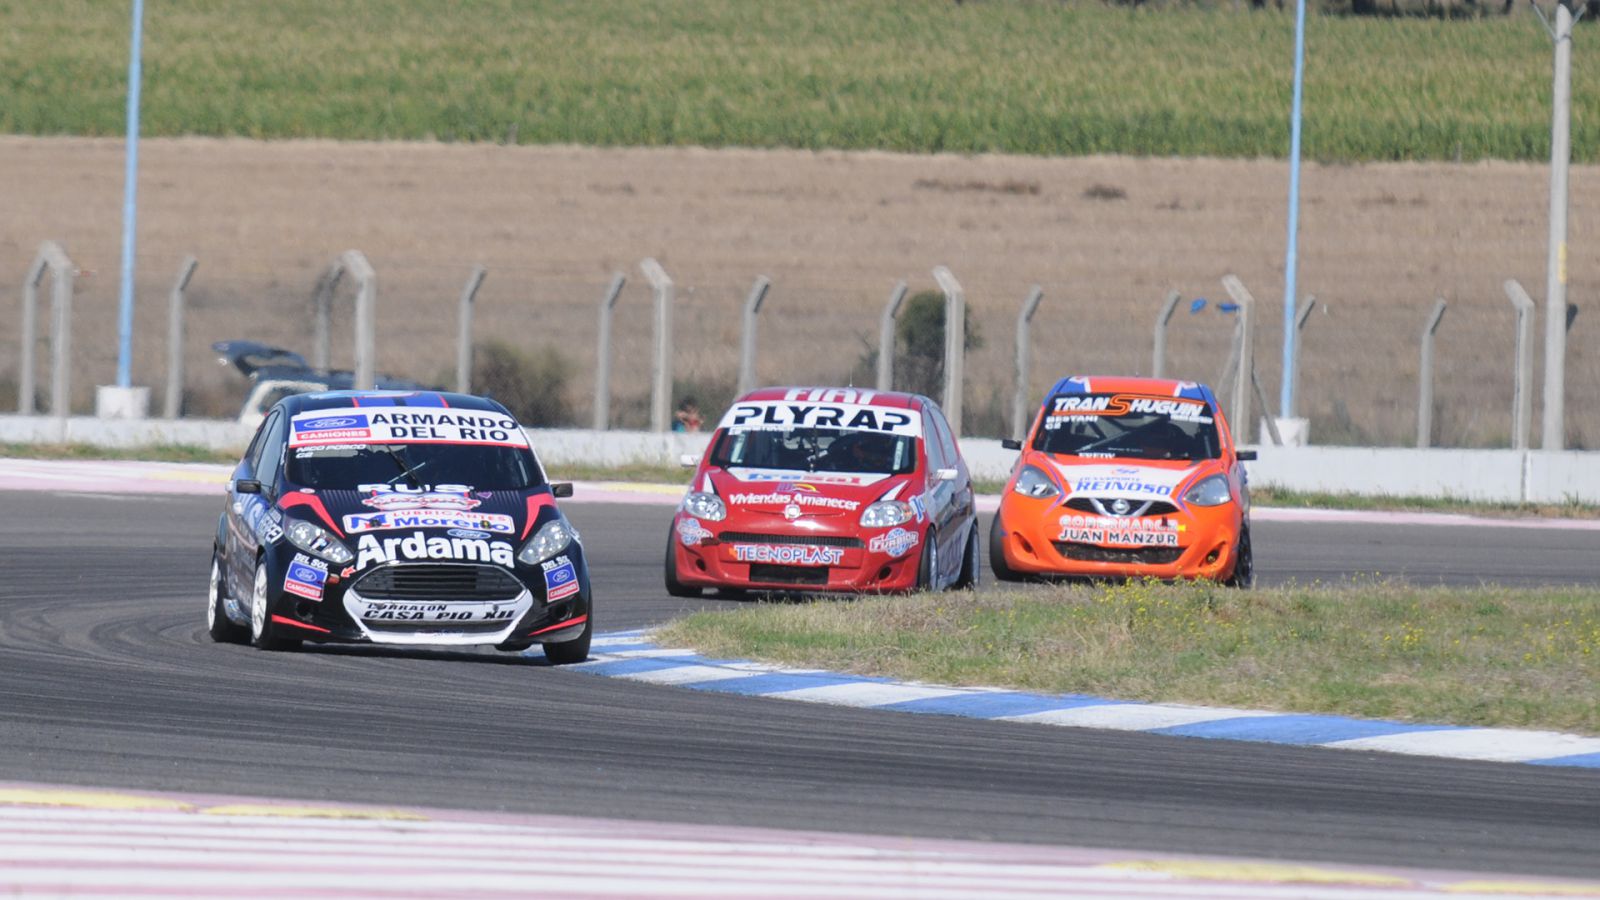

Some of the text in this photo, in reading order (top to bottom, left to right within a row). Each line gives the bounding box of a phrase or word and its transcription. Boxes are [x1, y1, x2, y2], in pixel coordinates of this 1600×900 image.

[372, 413, 519, 430] ARMANDO
[734, 406, 911, 431] PLYRAP
[301, 430, 367, 439] CAMIONES
[390, 427, 509, 441] DEL RIO
[1076, 480, 1172, 496] REINOSO
[729, 493, 861, 511] Viviendas Amanecer
[393, 510, 507, 522] LUBRICANTES
[394, 517, 509, 531] Moreno
[1060, 529, 1176, 545] JUAN MANZUR
[294, 553, 310, 564] DEL
[356, 531, 515, 570] Ardama
[736, 545, 843, 563] TECNOPLAST
[364, 610, 515, 620] CASA PIO XII
